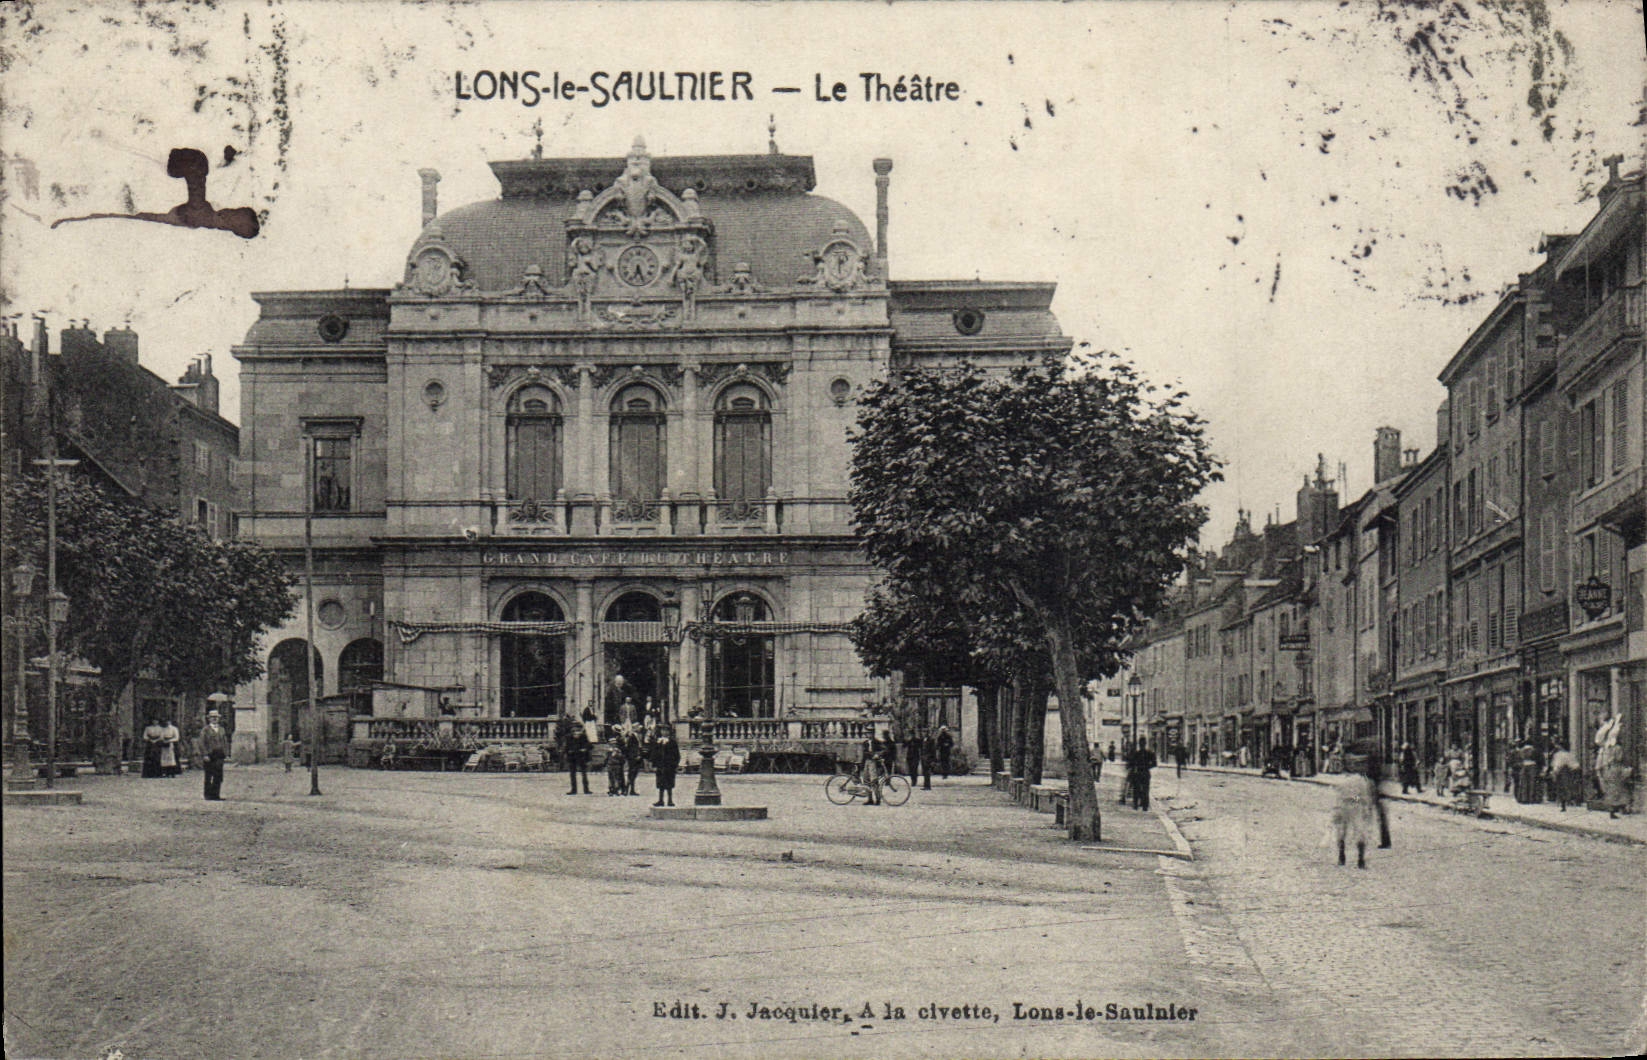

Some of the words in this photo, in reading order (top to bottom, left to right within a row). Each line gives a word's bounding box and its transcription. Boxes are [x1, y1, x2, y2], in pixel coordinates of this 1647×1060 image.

[483, 552, 557, 564] GRAND
[640, 552, 666, 564] DU
[679, 552, 789, 564] THEATRE
